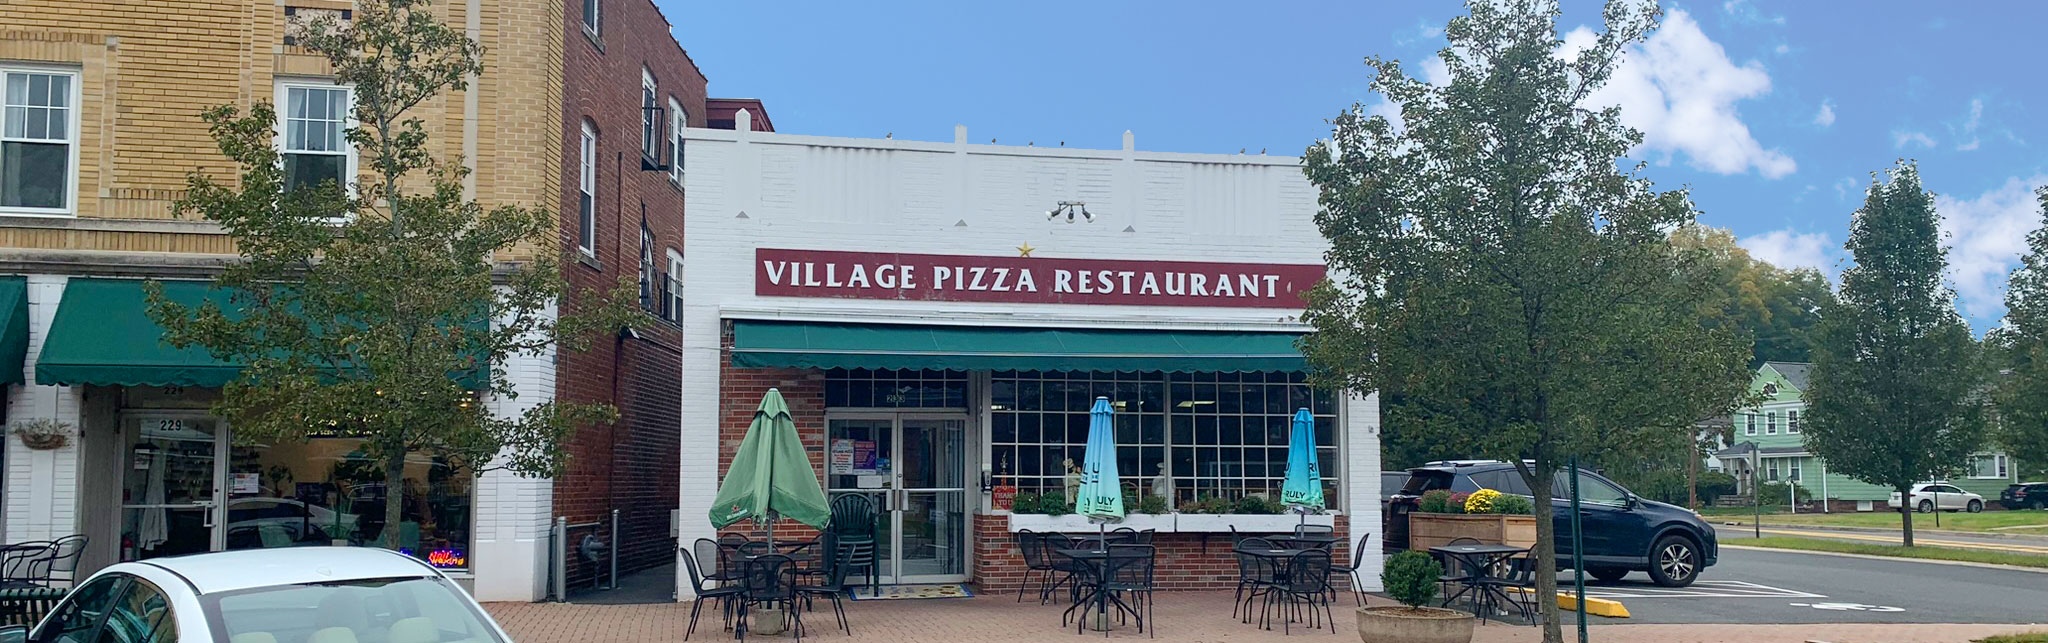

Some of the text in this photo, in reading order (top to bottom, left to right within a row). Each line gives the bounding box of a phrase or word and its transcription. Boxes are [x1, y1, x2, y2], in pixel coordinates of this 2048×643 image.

[764, 260, 1280, 298] VILLAGE PIZZA RESTAURANT
[160, 420, 182, 431] 229
[1285, 490, 1306, 499] RULY
